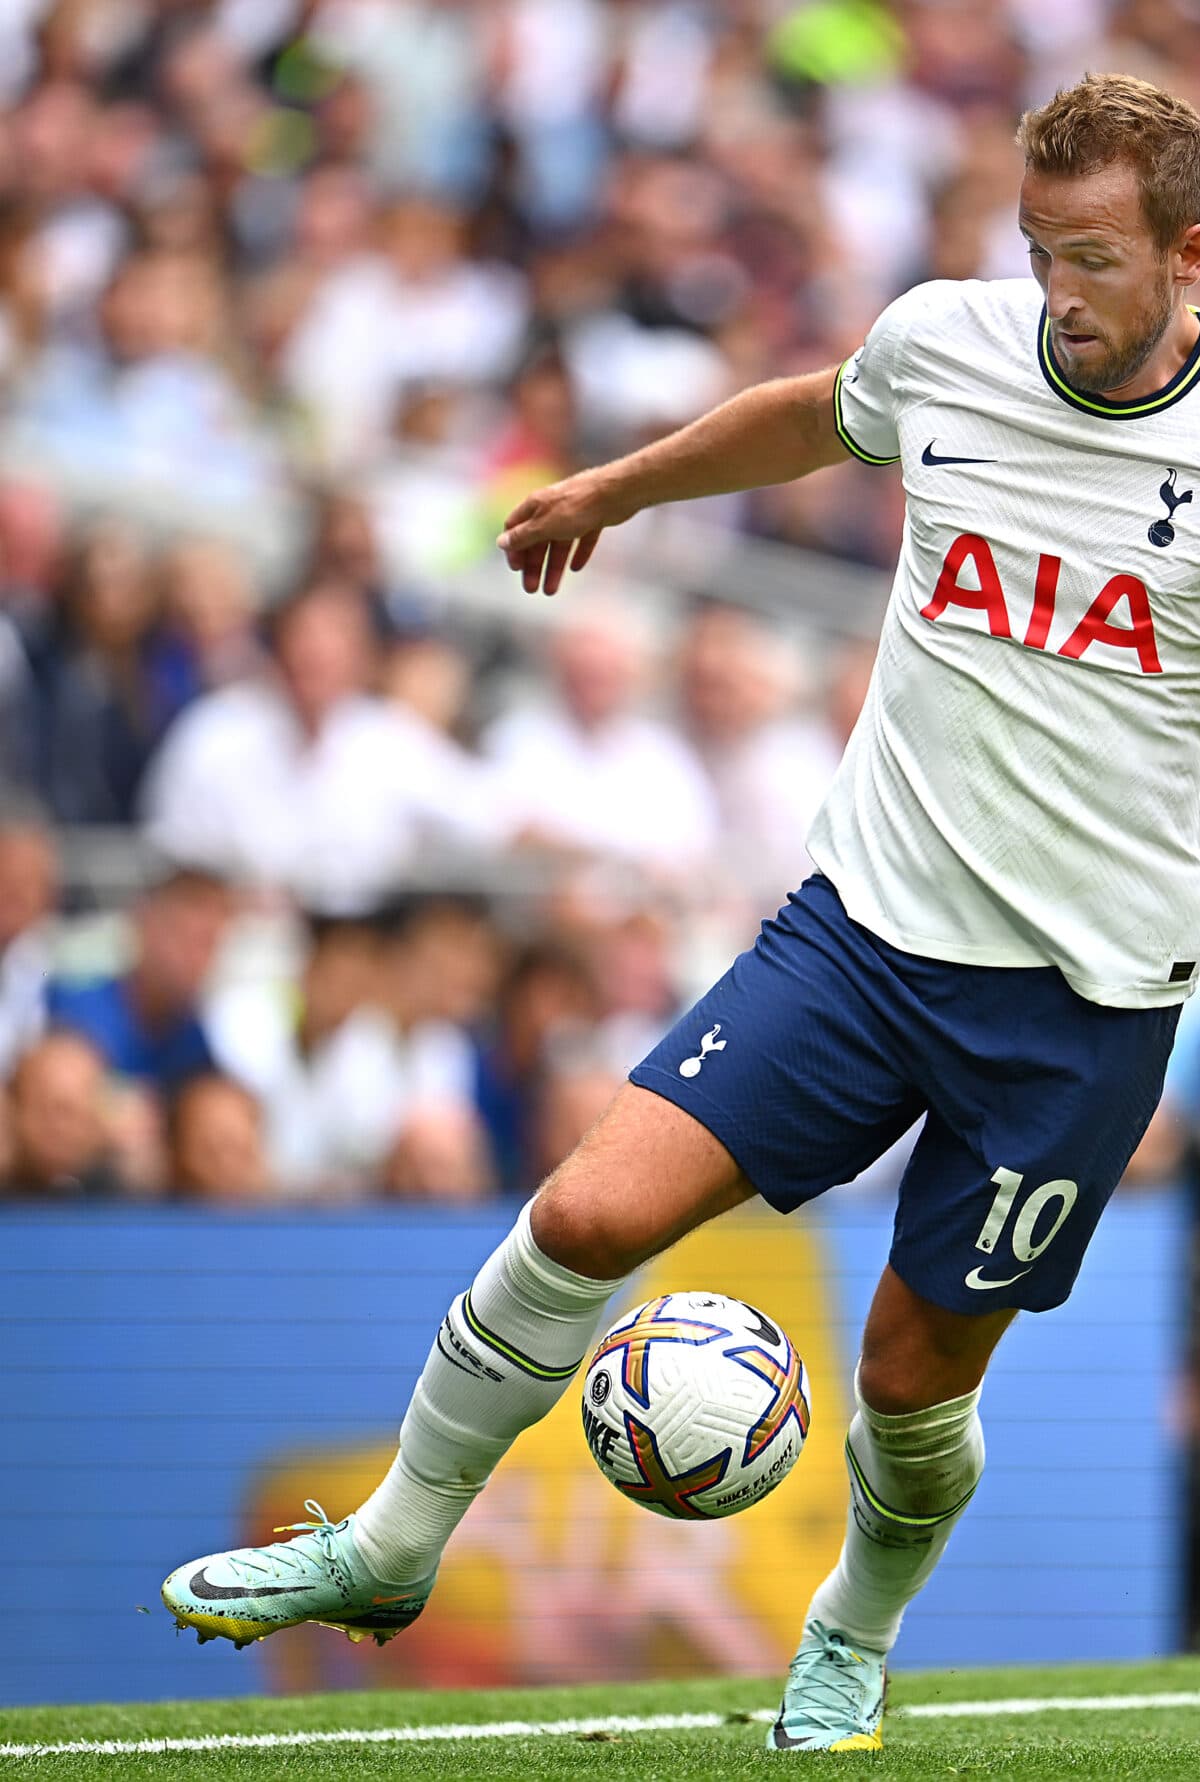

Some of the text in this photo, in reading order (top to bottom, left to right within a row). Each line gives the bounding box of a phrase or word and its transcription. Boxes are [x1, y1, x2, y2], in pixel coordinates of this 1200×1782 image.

[920, 533, 1164, 674] AIA
[975, 1166, 1078, 1262] 10
[716, 1485, 750, 1508] NIKE
[753, 1438, 793, 1490] FLIGHT
